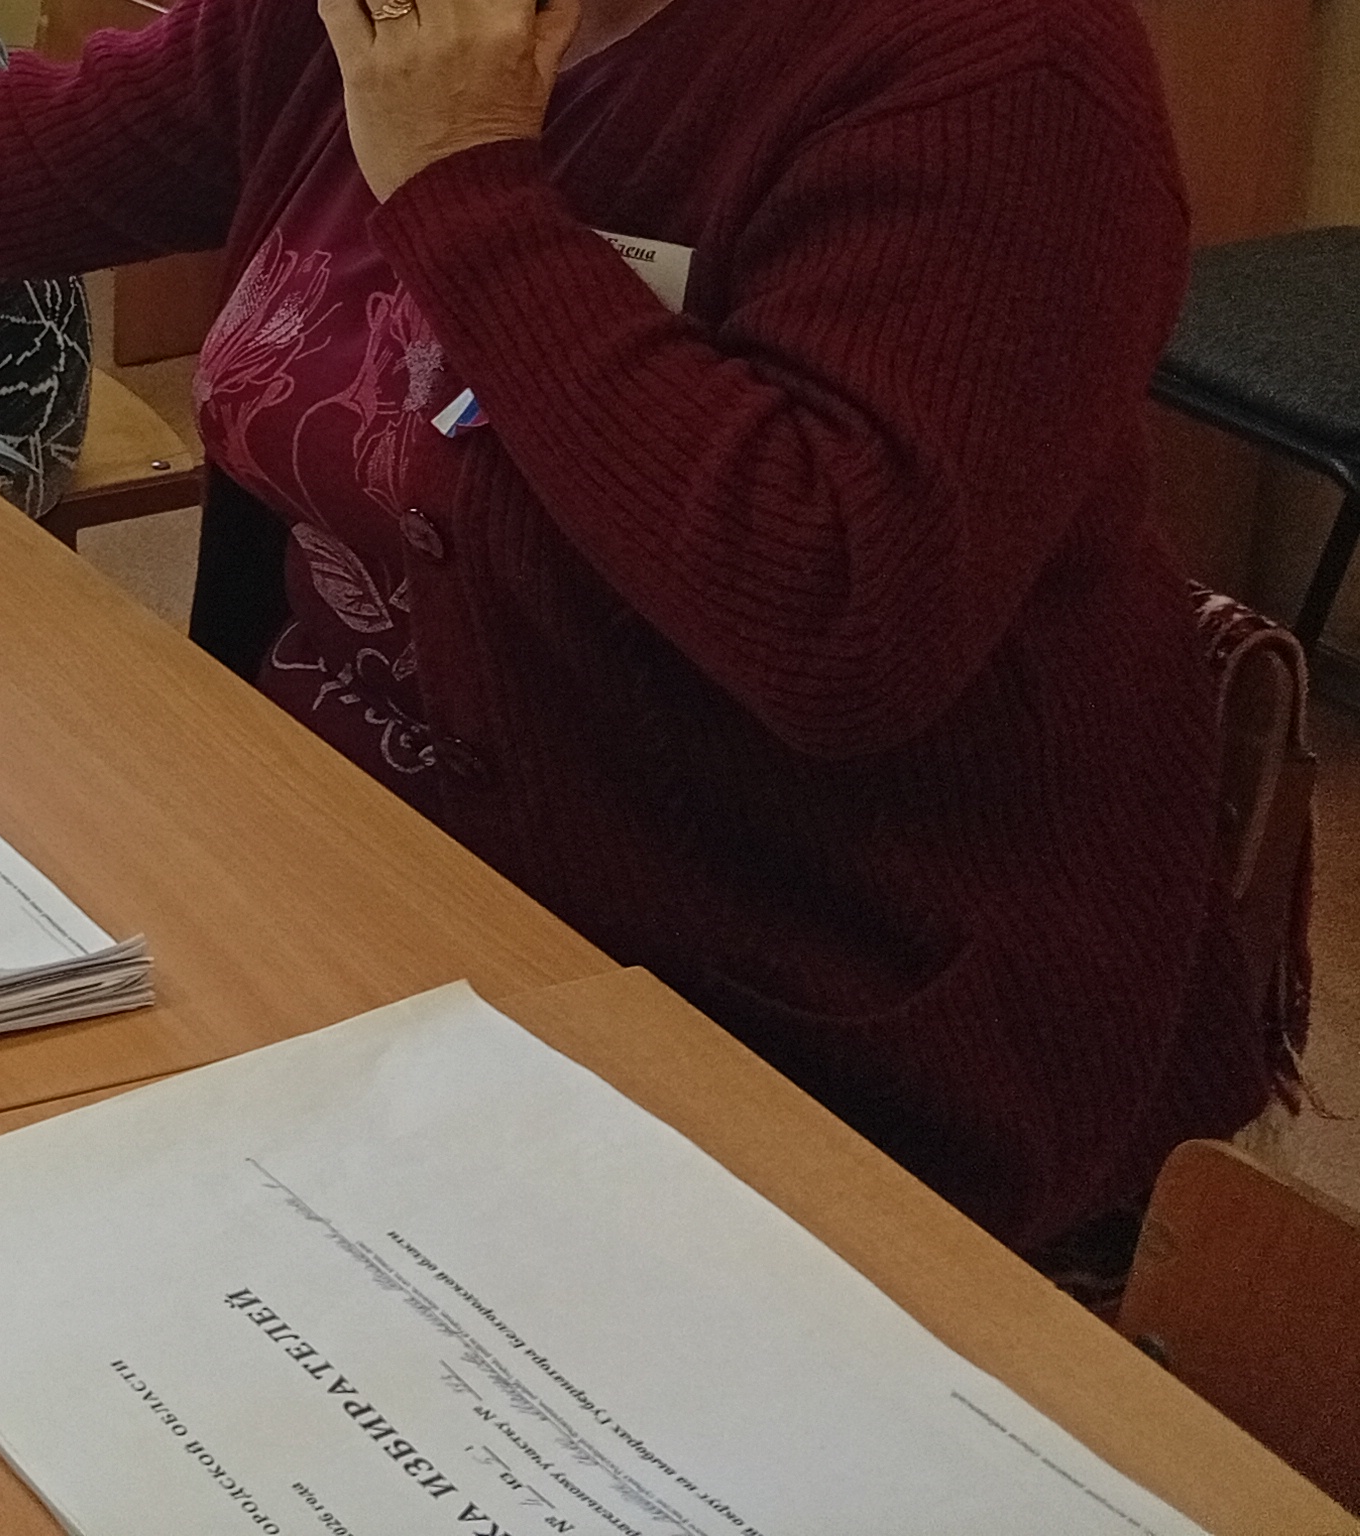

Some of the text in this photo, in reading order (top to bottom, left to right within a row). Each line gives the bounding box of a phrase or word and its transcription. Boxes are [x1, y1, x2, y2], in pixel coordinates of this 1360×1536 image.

[387, 1230, 440, 1272] области
[436, 1271, 525, 1349] Белгородской
[109, 1360, 189, 1438] ОБЛАСТИ
[224, 1287, 459, 1500] ИЗБИРАТЕЛЕЙ
[525, 1348, 611, 1425] Губернатора
[495, 1421, 555, 1471] участку
[611, 1424, 677, 1477] выборах
[292, 1482, 325, 1512] года
[677, 1476, 698, 1494] на
[696, 1492, 745, 1527] округ
